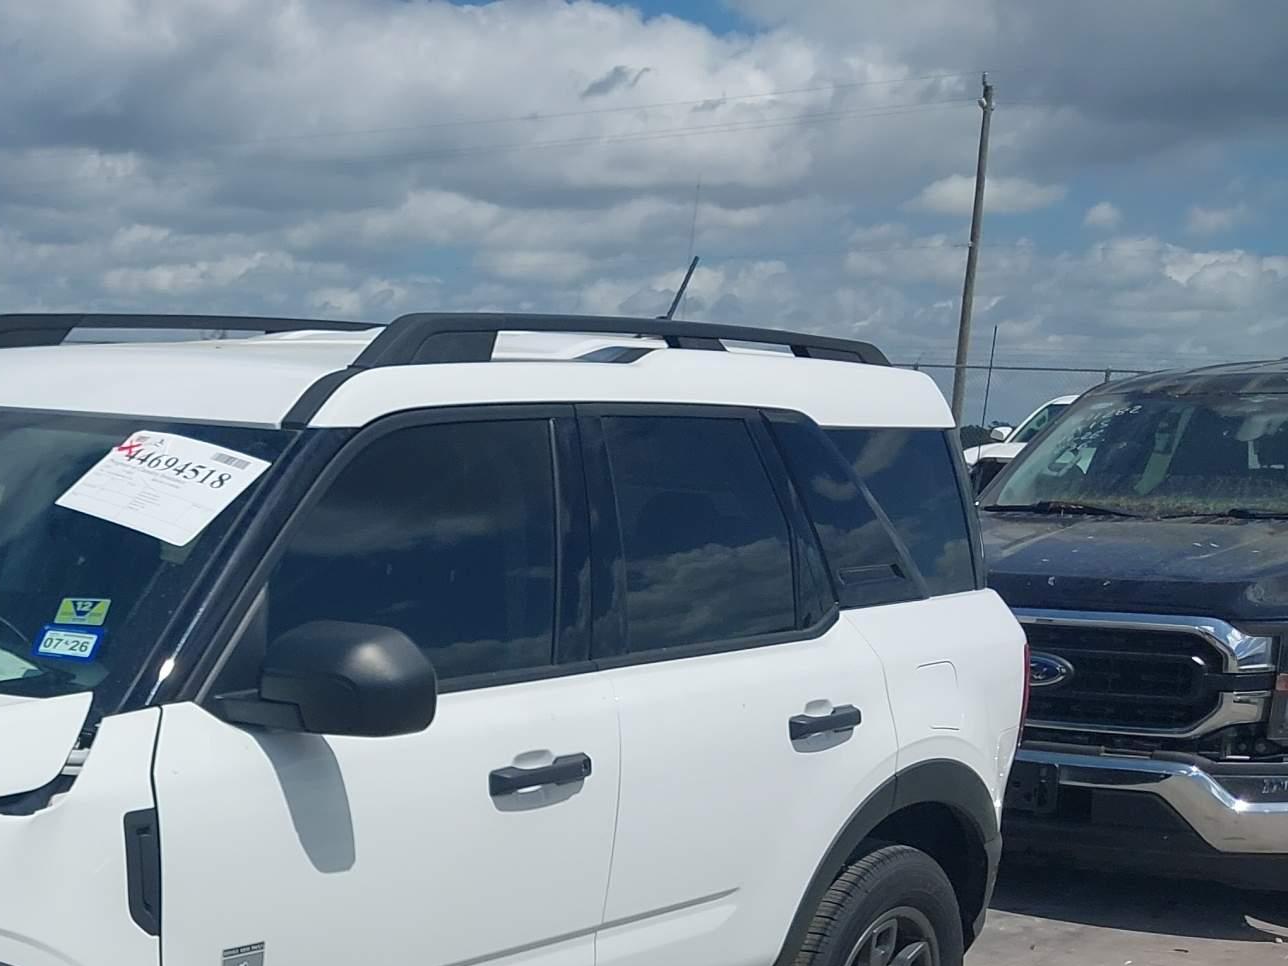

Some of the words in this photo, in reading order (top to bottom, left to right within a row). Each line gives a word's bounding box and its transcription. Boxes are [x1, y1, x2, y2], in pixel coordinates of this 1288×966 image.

[125, 449, 232, 489] 44694518
[75, 601, 93, 611] 12
[43, 637, 63, 649] 07
[68, 639, 90, 653] 26
